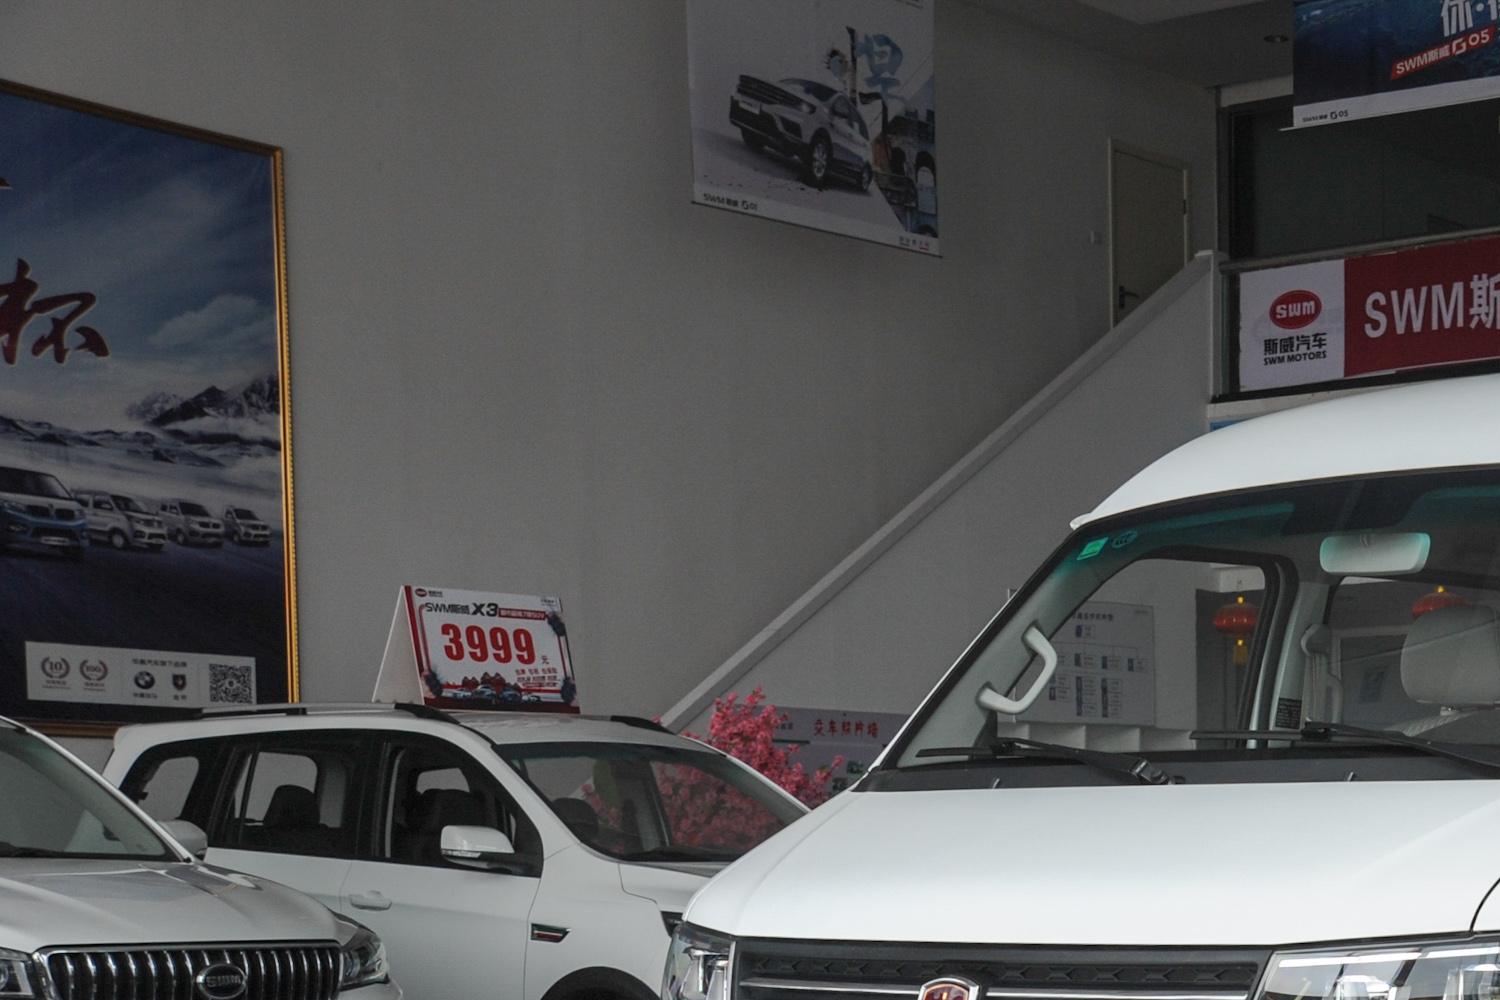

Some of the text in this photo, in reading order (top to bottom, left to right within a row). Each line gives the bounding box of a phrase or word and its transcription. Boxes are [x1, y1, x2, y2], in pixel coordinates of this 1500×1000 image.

[1275, 298, 1316, 320] SWM
[1263, 331, 1328, 357] 斯威汽车
[1263, 350, 1328, 367] SWM MOTORS
[471, 602, 499, 617] X3
[440, 622, 537, 666] 3999
